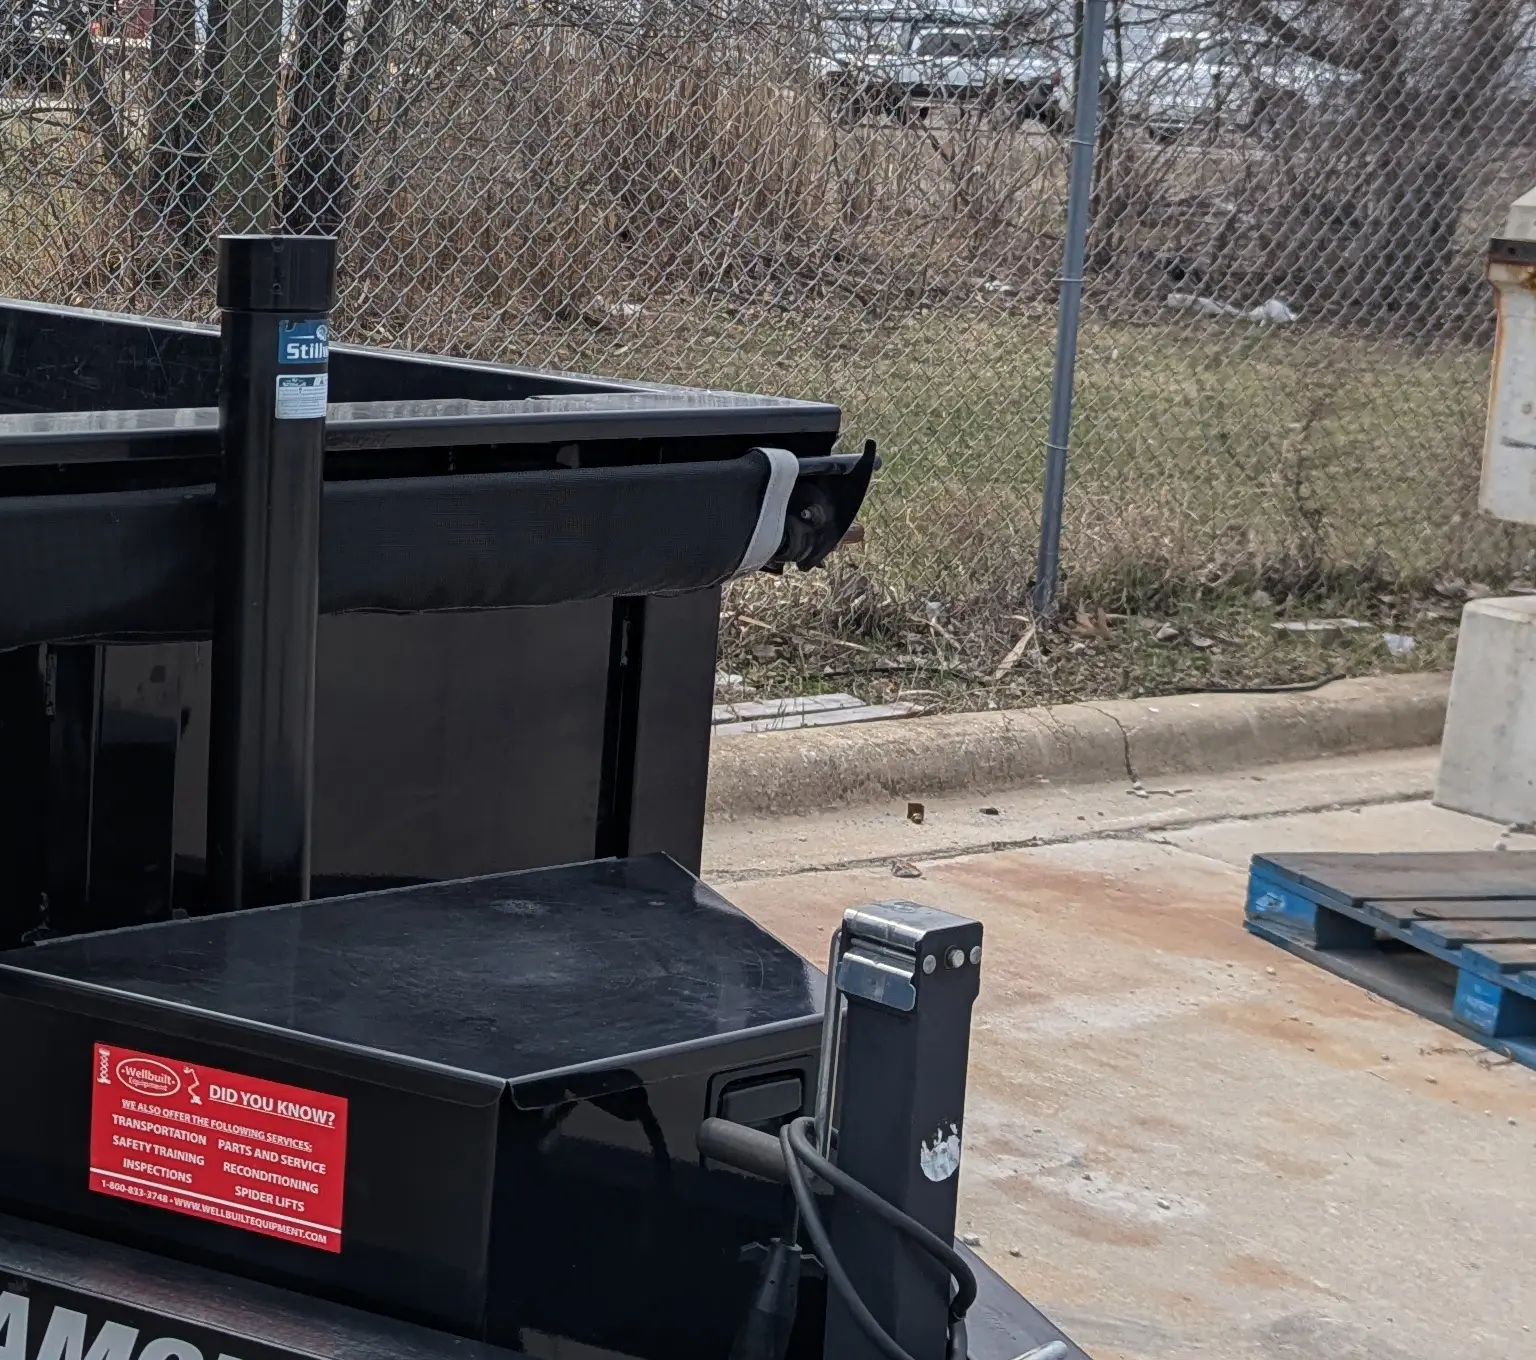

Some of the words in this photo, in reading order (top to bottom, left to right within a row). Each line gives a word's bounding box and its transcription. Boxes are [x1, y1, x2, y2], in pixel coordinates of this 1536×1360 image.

[124, 1065, 171, 1085] Wellbuilt
[128, 1076, 168, 1092] Equipment
[209, 1084, 238, 1103] DID
[240, 1091, 273, 1112] YOU
[277, 1100, 336, 1126] KNOW?
[112, 1113, 207, 1146] TRANSPORTATION
[121, 1098, 136, 1110] WE
[137, 1103, 161, 1116] ALSO
[162, 1108, 191, 1123] OFFER
[191, 1114, 209, 1128] THE
[210, 1119, 265, 1140] FOLLOWING
[266, 1133, 313, 1152] SERVICES:
[112, 1135, 152, 1153] SAFETY
[152, 1144, 205, 1166] TRAINING
[218, 1138, 252, 1157] PARTS
[253, 1148, 279, 1163] AND
[280, 1154, 327, 1175] SERVICE
[123, 1157, 193, 1184] INSPECTIONS
[223, 1161, 319, 1194] RECONDITIONING
[234, 1185, 274, 1204] SPIDER
[275, 1195, 305, 1212] LIFTS
[173, 1196, 327, 1245] WWW.WELLBUILTEQUIPMENT.COM
